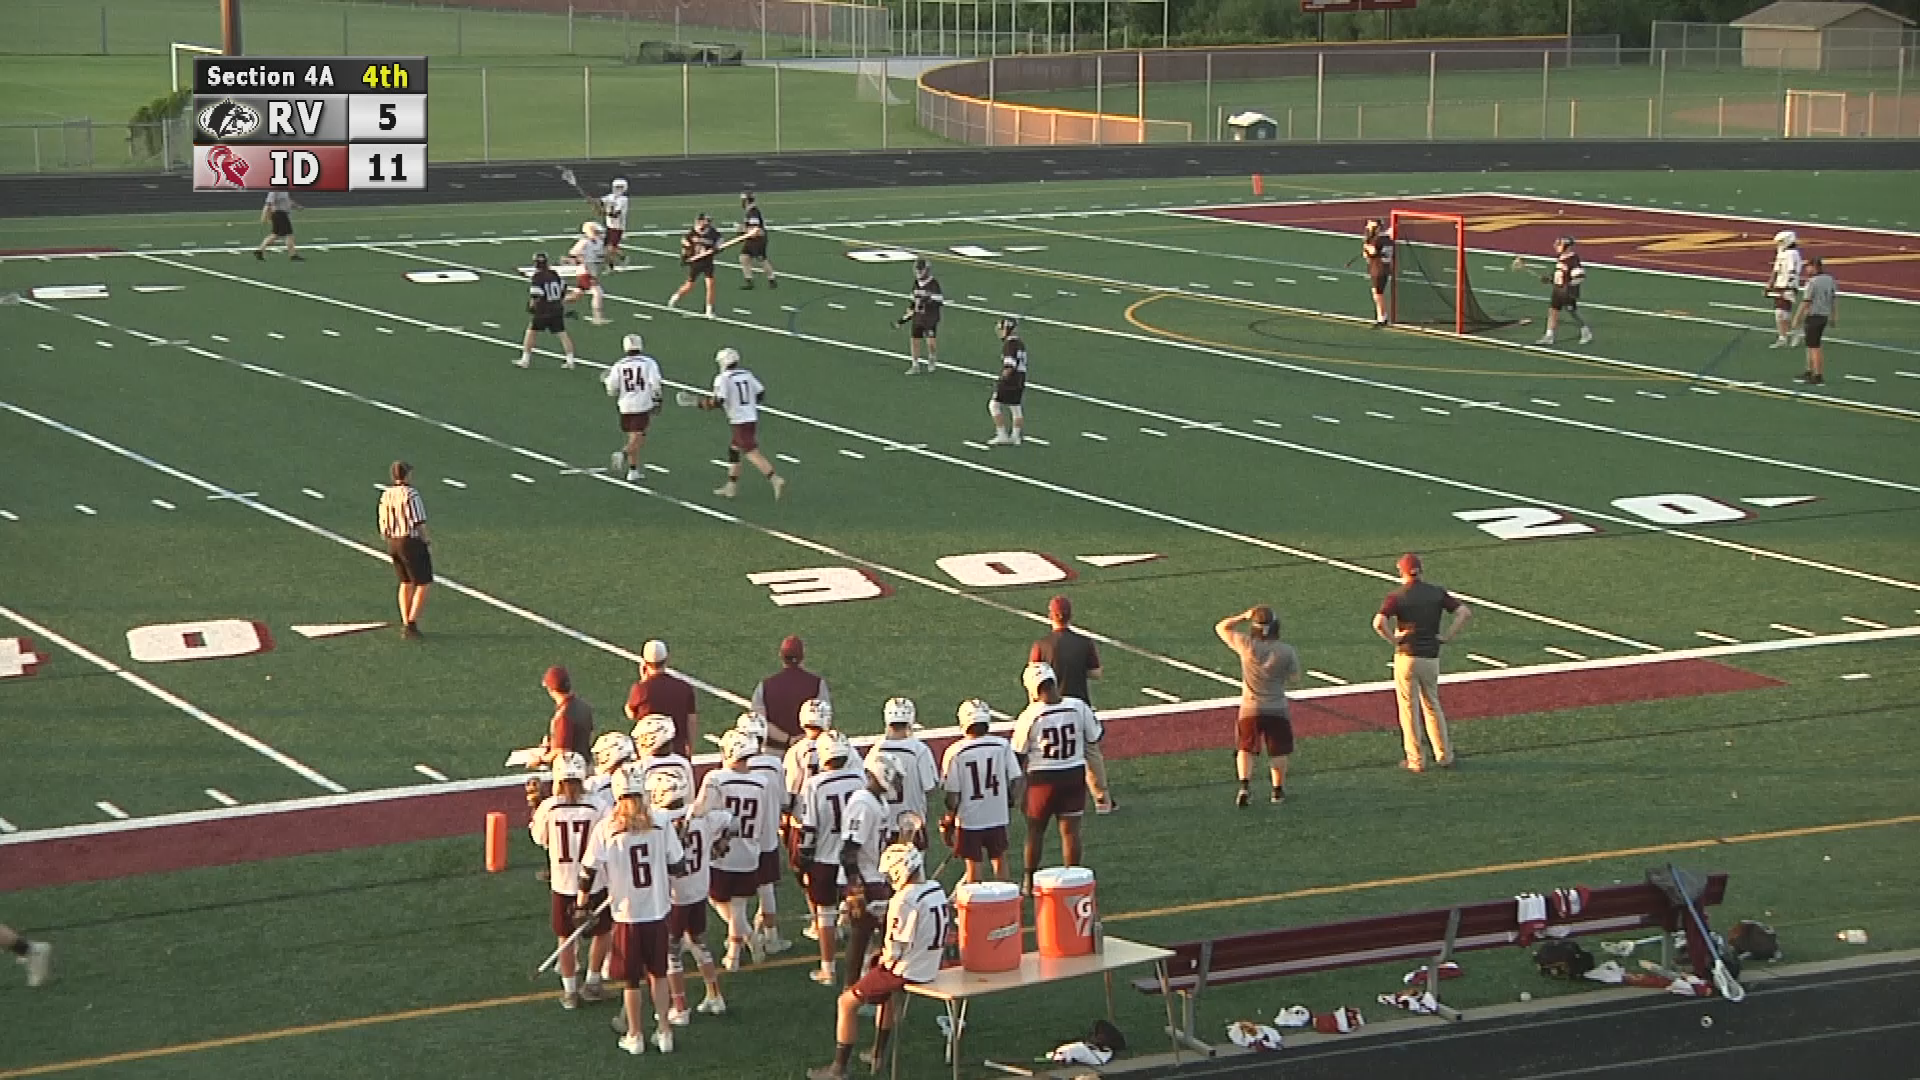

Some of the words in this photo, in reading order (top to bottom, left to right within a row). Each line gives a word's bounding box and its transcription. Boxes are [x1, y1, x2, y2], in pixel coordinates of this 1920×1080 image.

[544, 281, 560, 301] 10
[622, 365, 645, 393] 24
[1451, 494, 1752, 541] 20
[746, 551, 1078, 606] 30
[1041, 723, 1077, 760] 26
[965, 757, 1000, 801] 14
[554, 818, 592, 864] 17
[629, 843, 652, 889] 6
[1077, 896, 1092, 920] G
